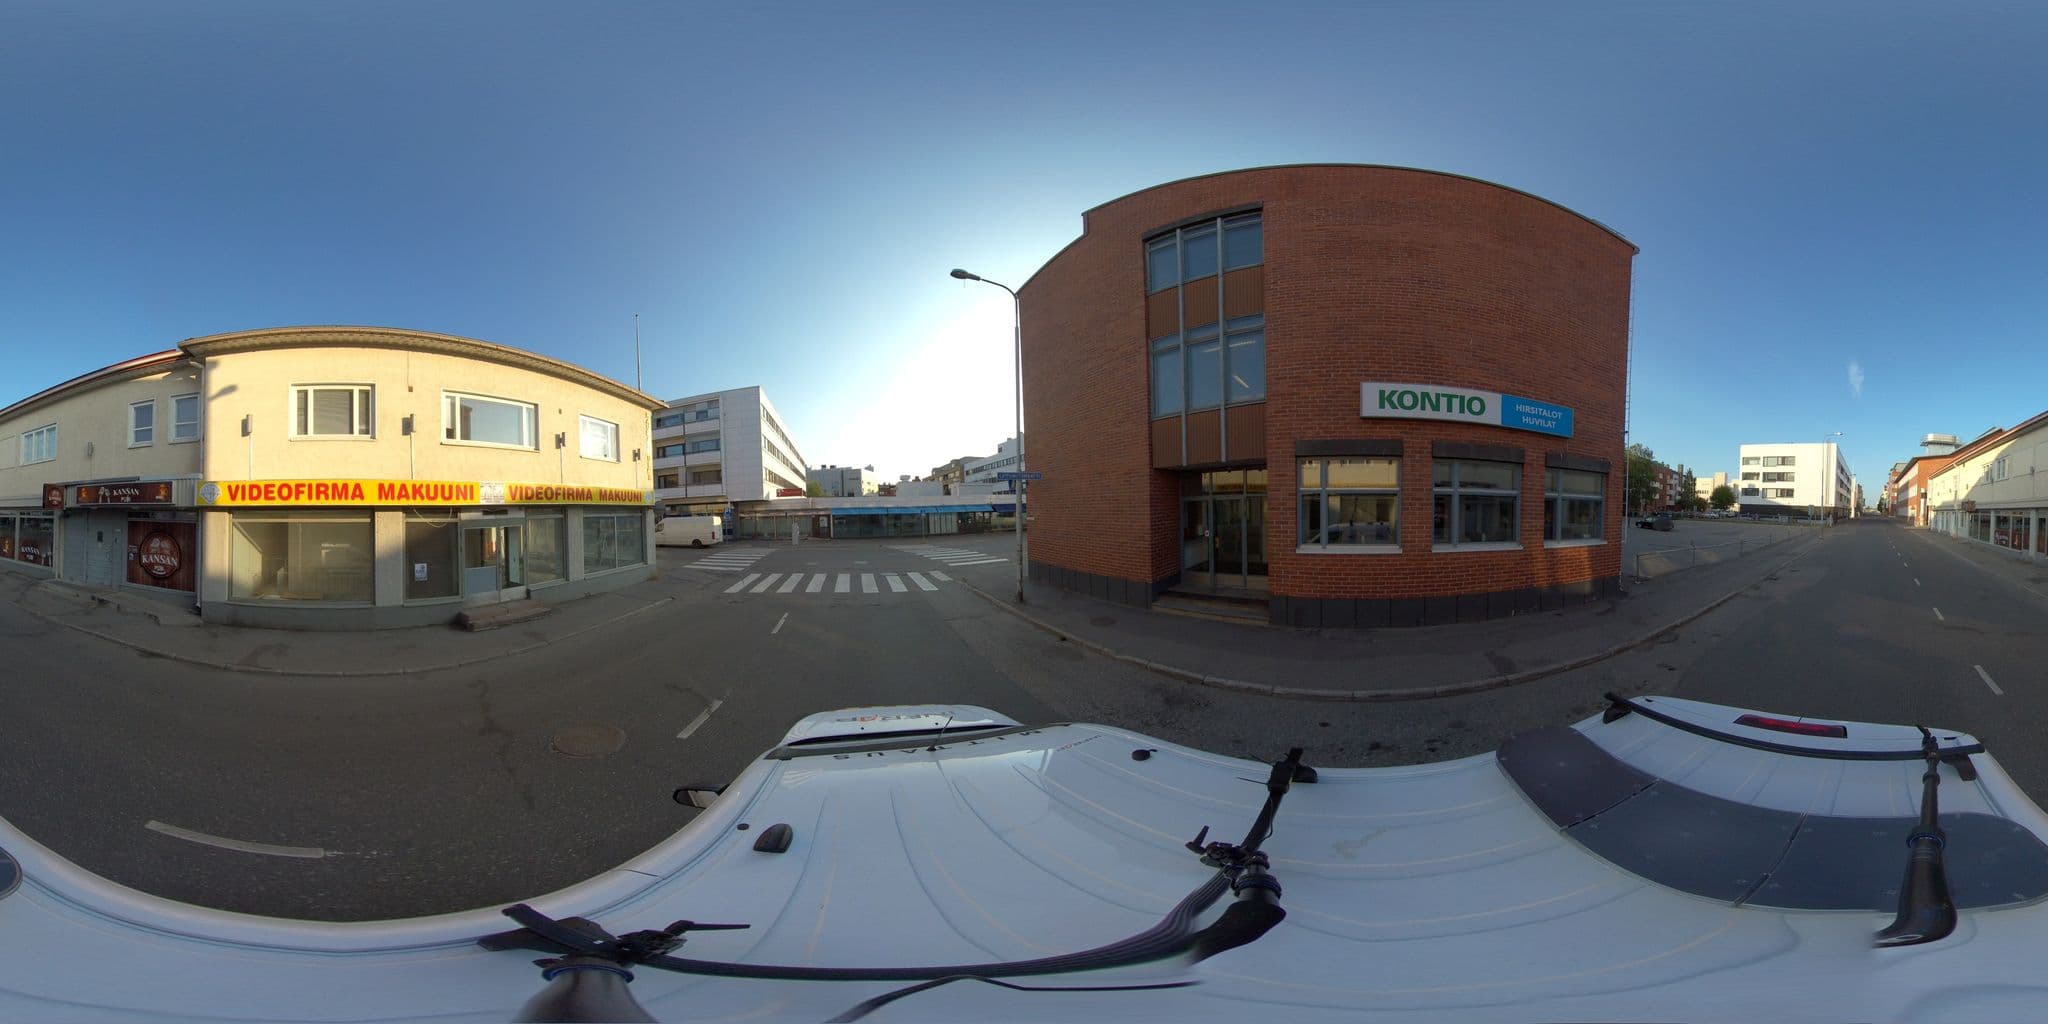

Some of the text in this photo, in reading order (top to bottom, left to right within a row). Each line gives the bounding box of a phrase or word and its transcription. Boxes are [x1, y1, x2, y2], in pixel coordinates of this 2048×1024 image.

[1378, 389, 1486, 416] KONTIO
[1515, 404, 1562, 419] HIRSITALOT
[1522, 416, 1556, 429] HUVILAT
[112, 488, 140, 496] KANSAN
[227, 482, 364, 501] VIDEOFIRMA
[377, 483, 475, 501] MAKUUNI
[508, 485, 593, 501] VIDEOFIRMA
[600, 489, 642, 503] MAKUUNI
[142, 554, 178, 567] KANSAN
